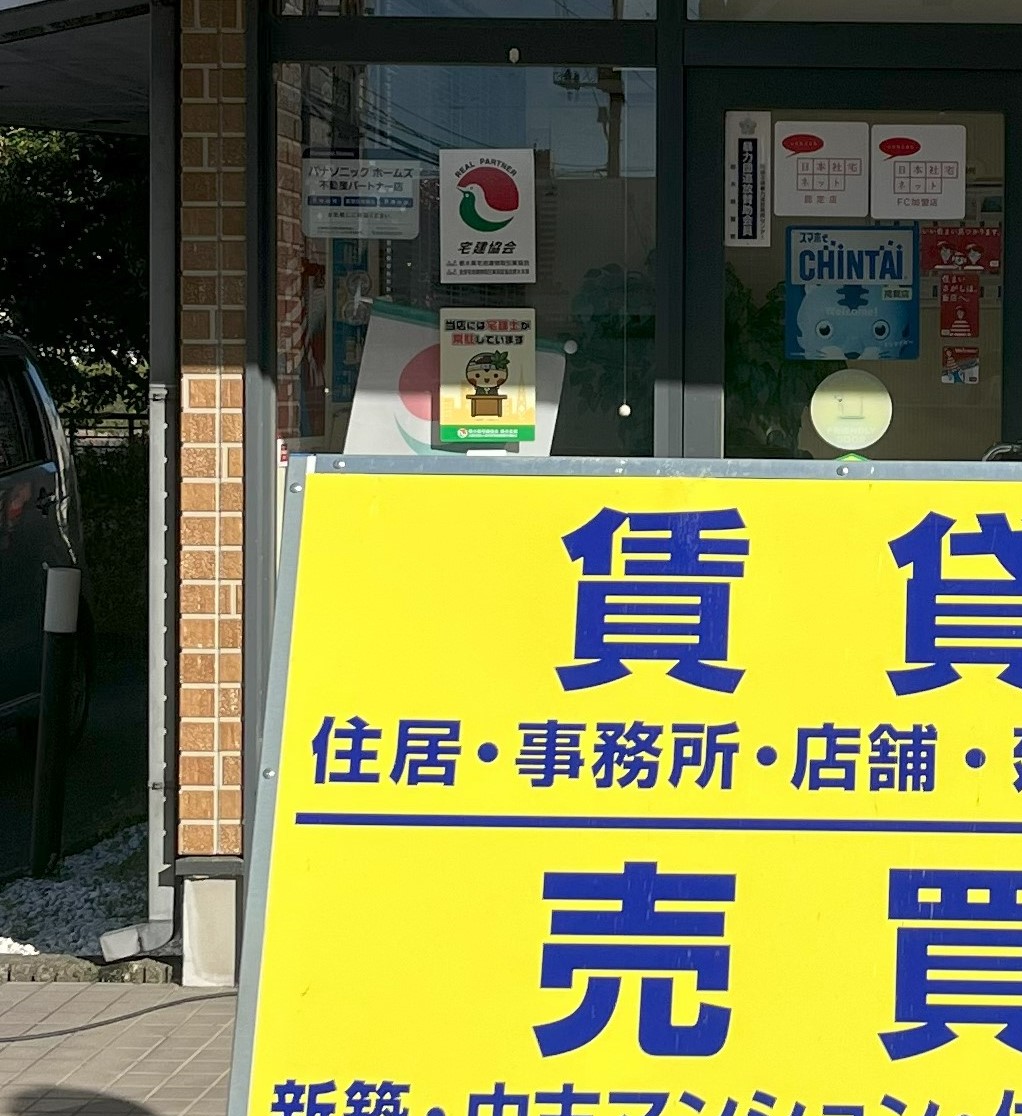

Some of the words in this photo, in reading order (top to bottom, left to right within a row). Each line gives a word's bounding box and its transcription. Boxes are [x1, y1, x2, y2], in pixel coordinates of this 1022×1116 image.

[372, 167, 414, 179] ホームズ
[454, 160, 476, 178] REAL
[479, 157, 518, 177] PARTNER
[898, 165, 955, 176] 日本社宅
[898, 181, 937, 191] ネット
[896, 197, 939, 207] FC加盟店
[457, 240, 517, 255] 宅建協会
[799, 243, 904, 281] CHINTAI
